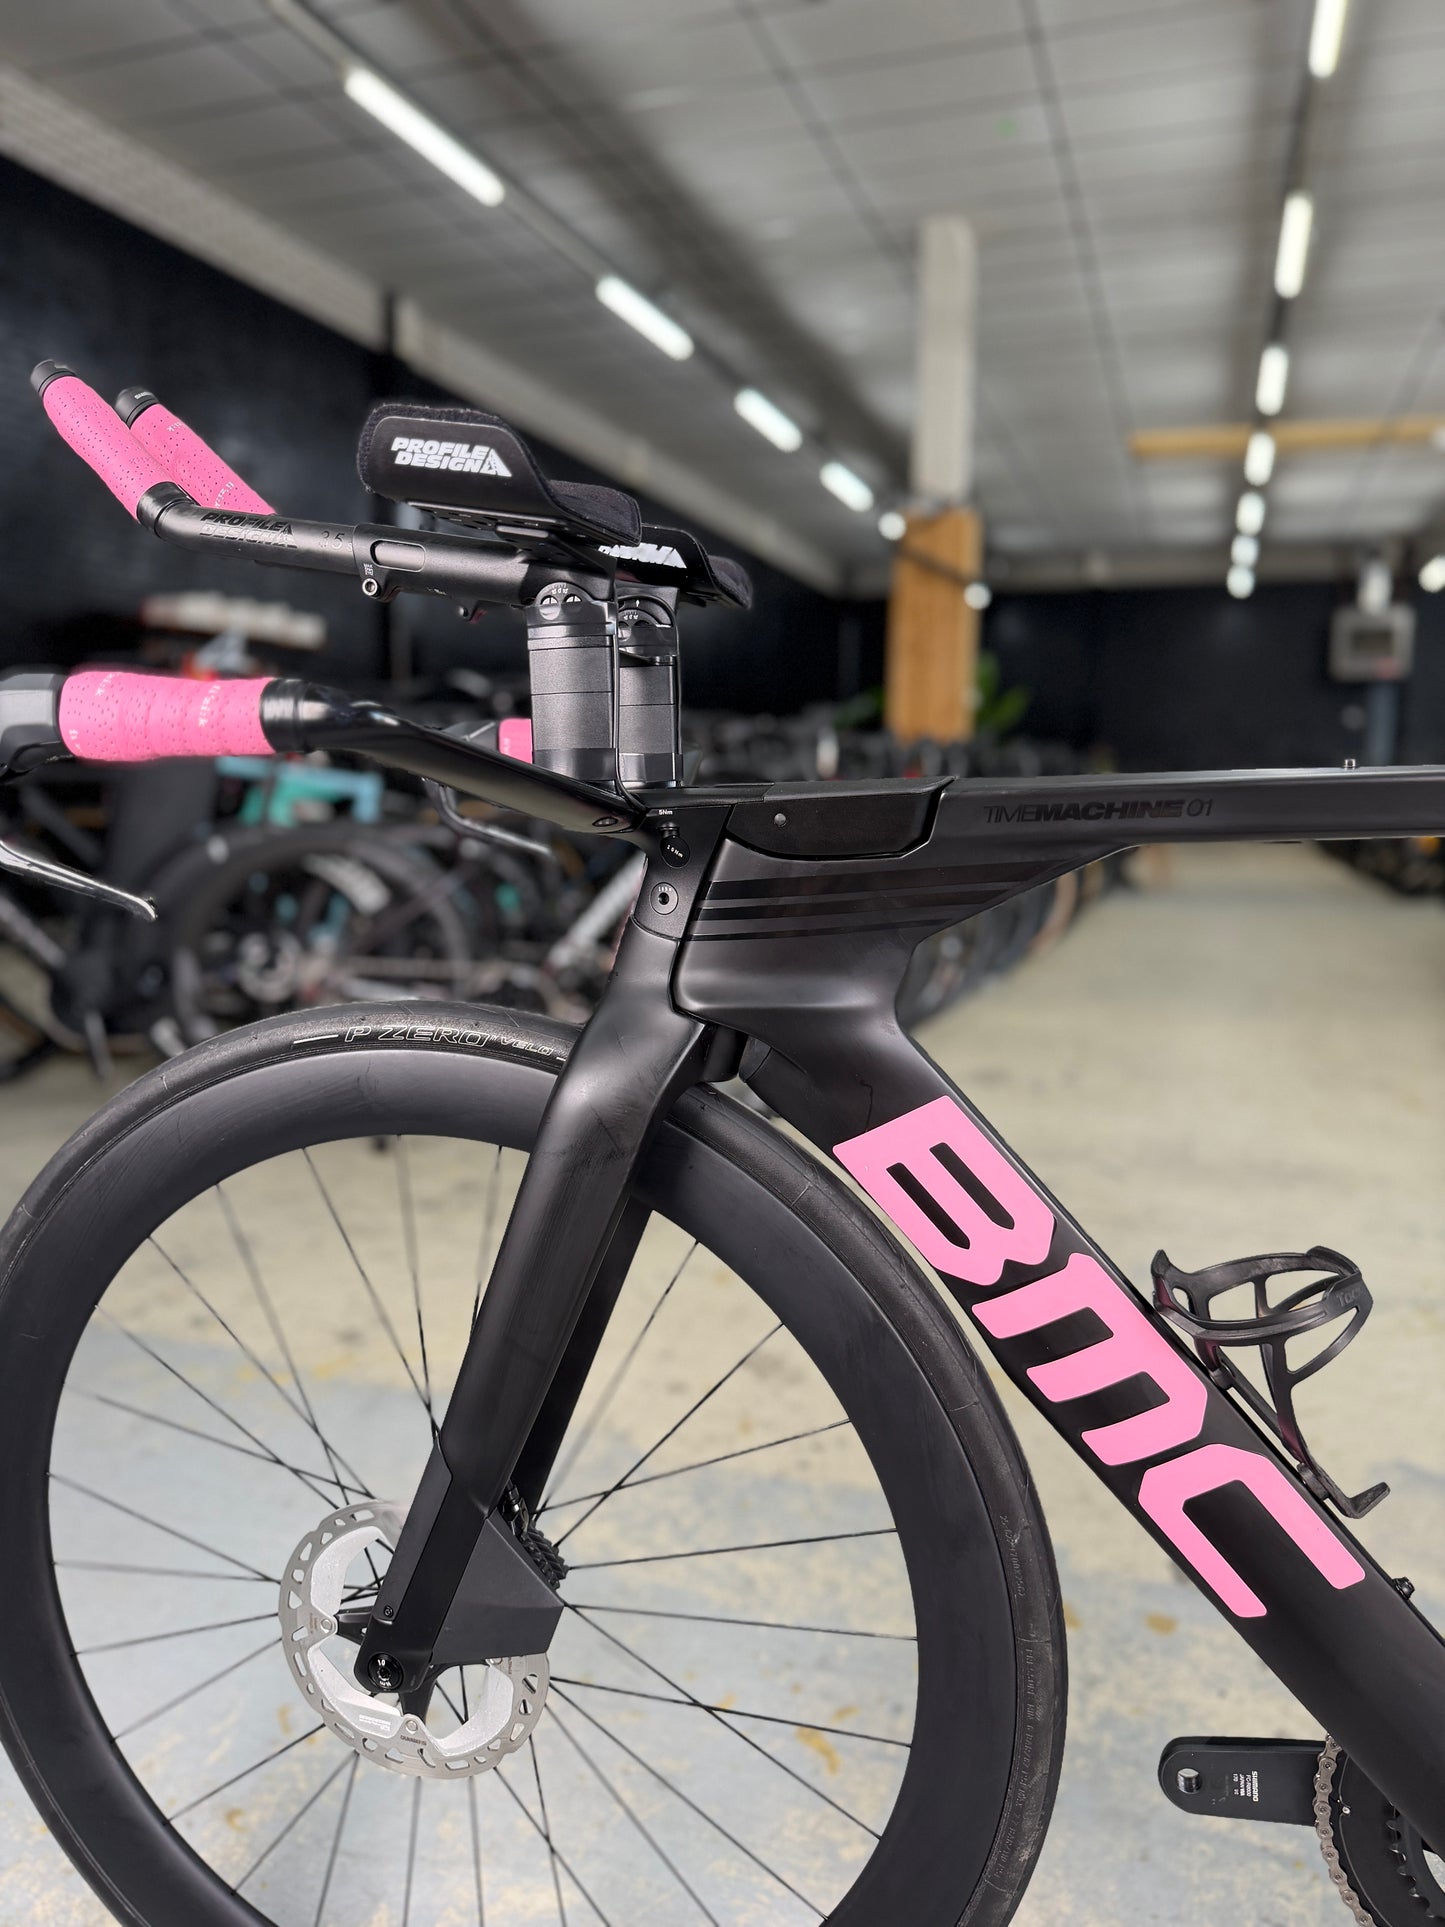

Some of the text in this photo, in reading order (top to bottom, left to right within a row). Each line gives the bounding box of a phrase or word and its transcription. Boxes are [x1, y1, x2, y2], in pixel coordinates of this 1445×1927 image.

[390, 436, 490, 460] PROFILE
[394, 450, 483, 473] DESIGN
[200, 512, 288, 532] PROFILE
[199, 522, 280, 548] DESIGN
[658, 808, 673, 816] 5Nm
[983, 798, 1214, 824] TIMEMACHINE 01
[345, 1025, 555, 1057] P ZERO VELO
[833, 1097, 1364, 1617] BMC
